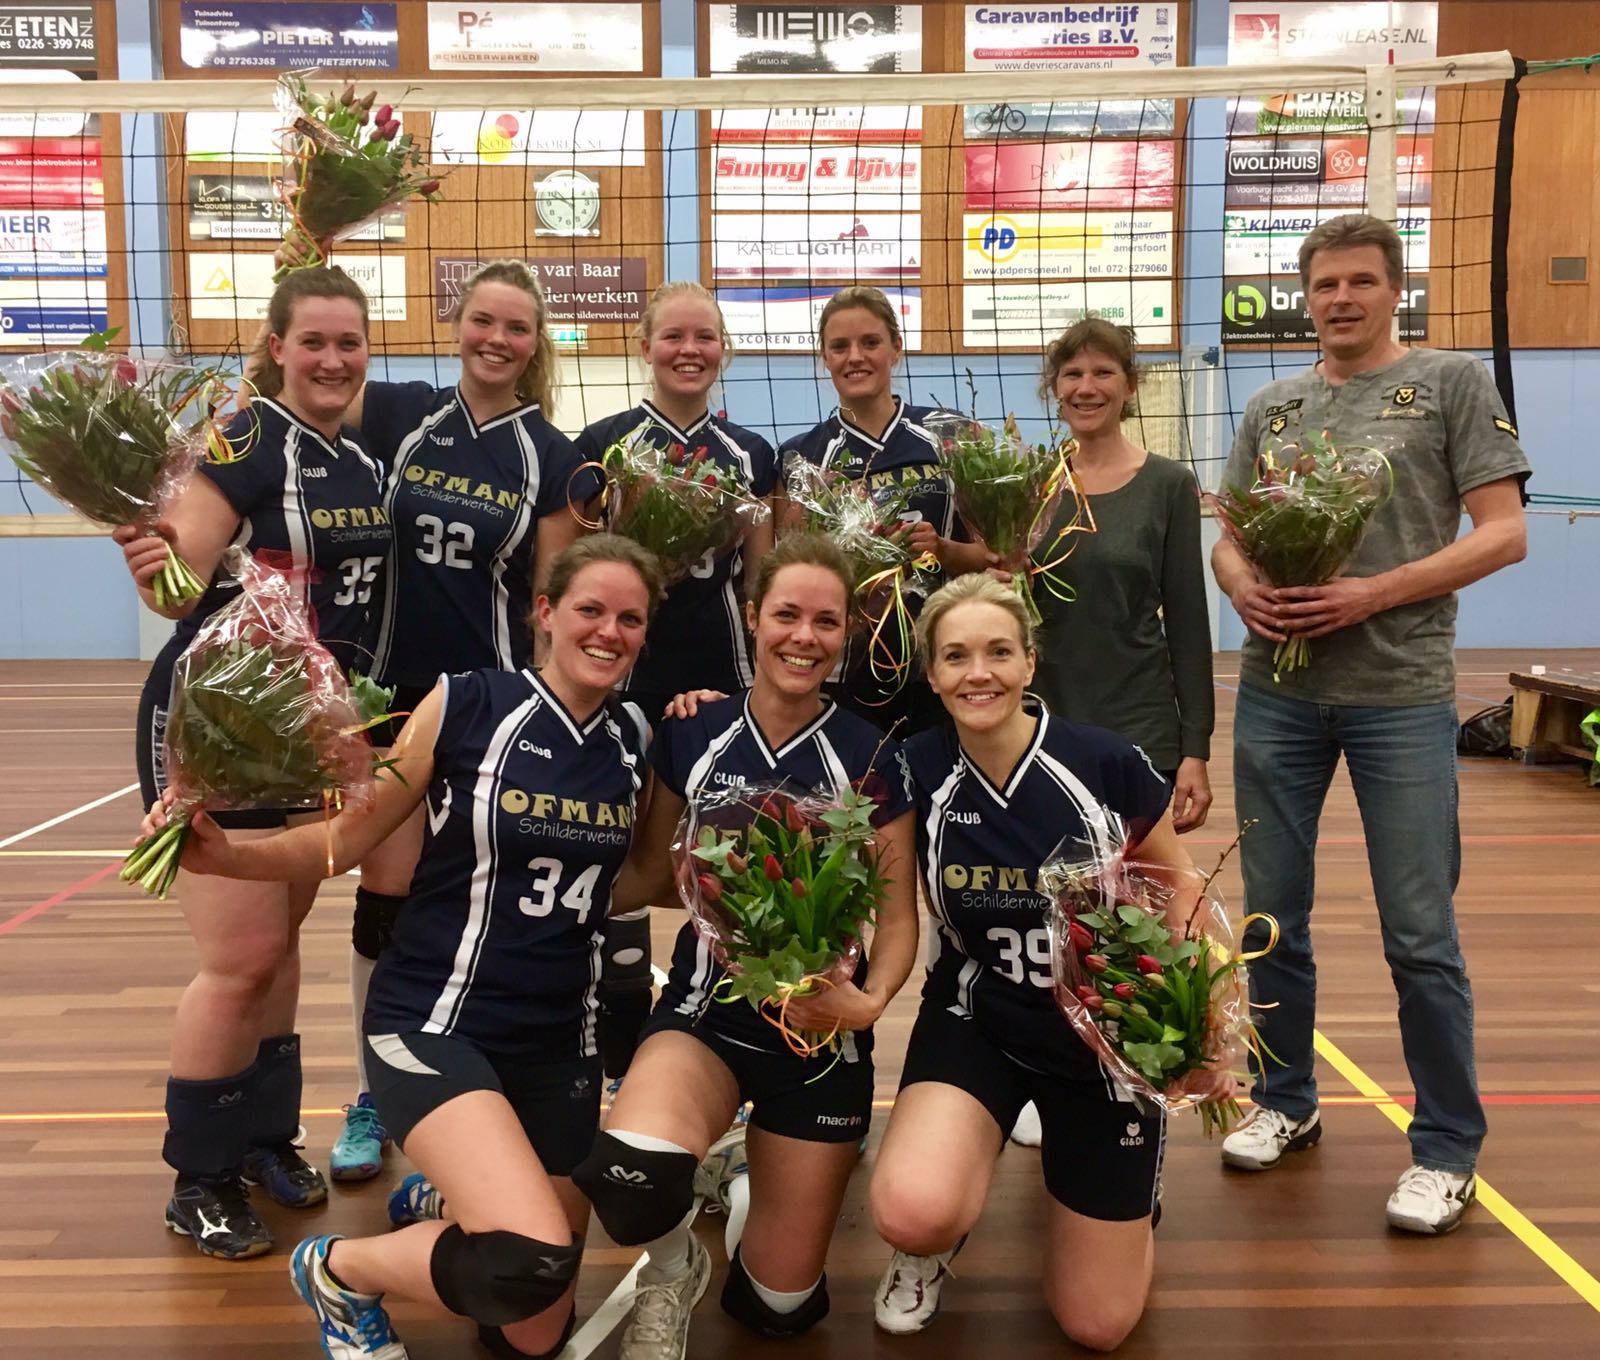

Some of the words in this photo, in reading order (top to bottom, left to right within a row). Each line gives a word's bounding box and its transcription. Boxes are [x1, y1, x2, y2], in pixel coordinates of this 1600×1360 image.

[195, 19, 240, 28] Tuinontwerp
[975, 6, 1139, 27] Caravanbedrijf
[15, 16, 79, 37] ETEN
[262, 31, 334, 46] PIETER
[340, 31, 389, 46] TUIN
[1098, 29, 1138, 44] B.V.
[18, 39, 44, 49] 0226
[75, 39, 94, 49] 748
[213, 57, 226, 66] 06
[229, 57, 276, 66] 27263365
[756, 58, 789, 66] MEMO.NL
[995, 60, 1113, 71] www.devriescaravans.nl
[1232, 155, 1317, 170] WOLDHUIS
[1357, 154, 1425, 167] eert
[716, 157, 809, 182] Sunny
[815, 157, 838, 177] &
[847, 157, 918, 182] Djive
[214, 224, 272, 233] Statonsstraat
[1114, 219, 1152, 229] alkmaar
[1249, 218, 1312, 231] KLAVER
[983, 227, 1016, 250] PD
[737, 242, 795, 255] KAREL
[797, 242, 896, 255] LIGTHART
[1113, 243, 1167, 253] amersfoort
[583, 263, 621, 277] Baar
[973, 264, 1072, 275] www.pdpersoneel.nl
[1088, 264, 1103, 274] tel.
[543, 288, 639, 304] derwerken
[738, 334, 790, 344] SCOREN
[1283, 331, 1297, 339] Gas
[428, 433, 455, 447] CLUB
[301, 466, 329, 478] CLUB
[404, 464, 524, 511] OFMAN
[409, 484, 504, 519] Schilderwerken
[330, 529, 392, 543] Schilderwerke
[414, 513, 476, 570] 32
[518, 739, 553, 759] CLUB
[714, 771, 746, 788] CLUB
[500, 789, 632, 829] OFMAN
[945, 810, 982, 825] CLUB
[518, 818, 627, 846] Schilderwerken
[518, 856, 602, 924] 34
[961, 892, 1054, 910] Schilderwe
[986, 927, 1055, 988] 39
[816, 1113, 862, 1127] macron
